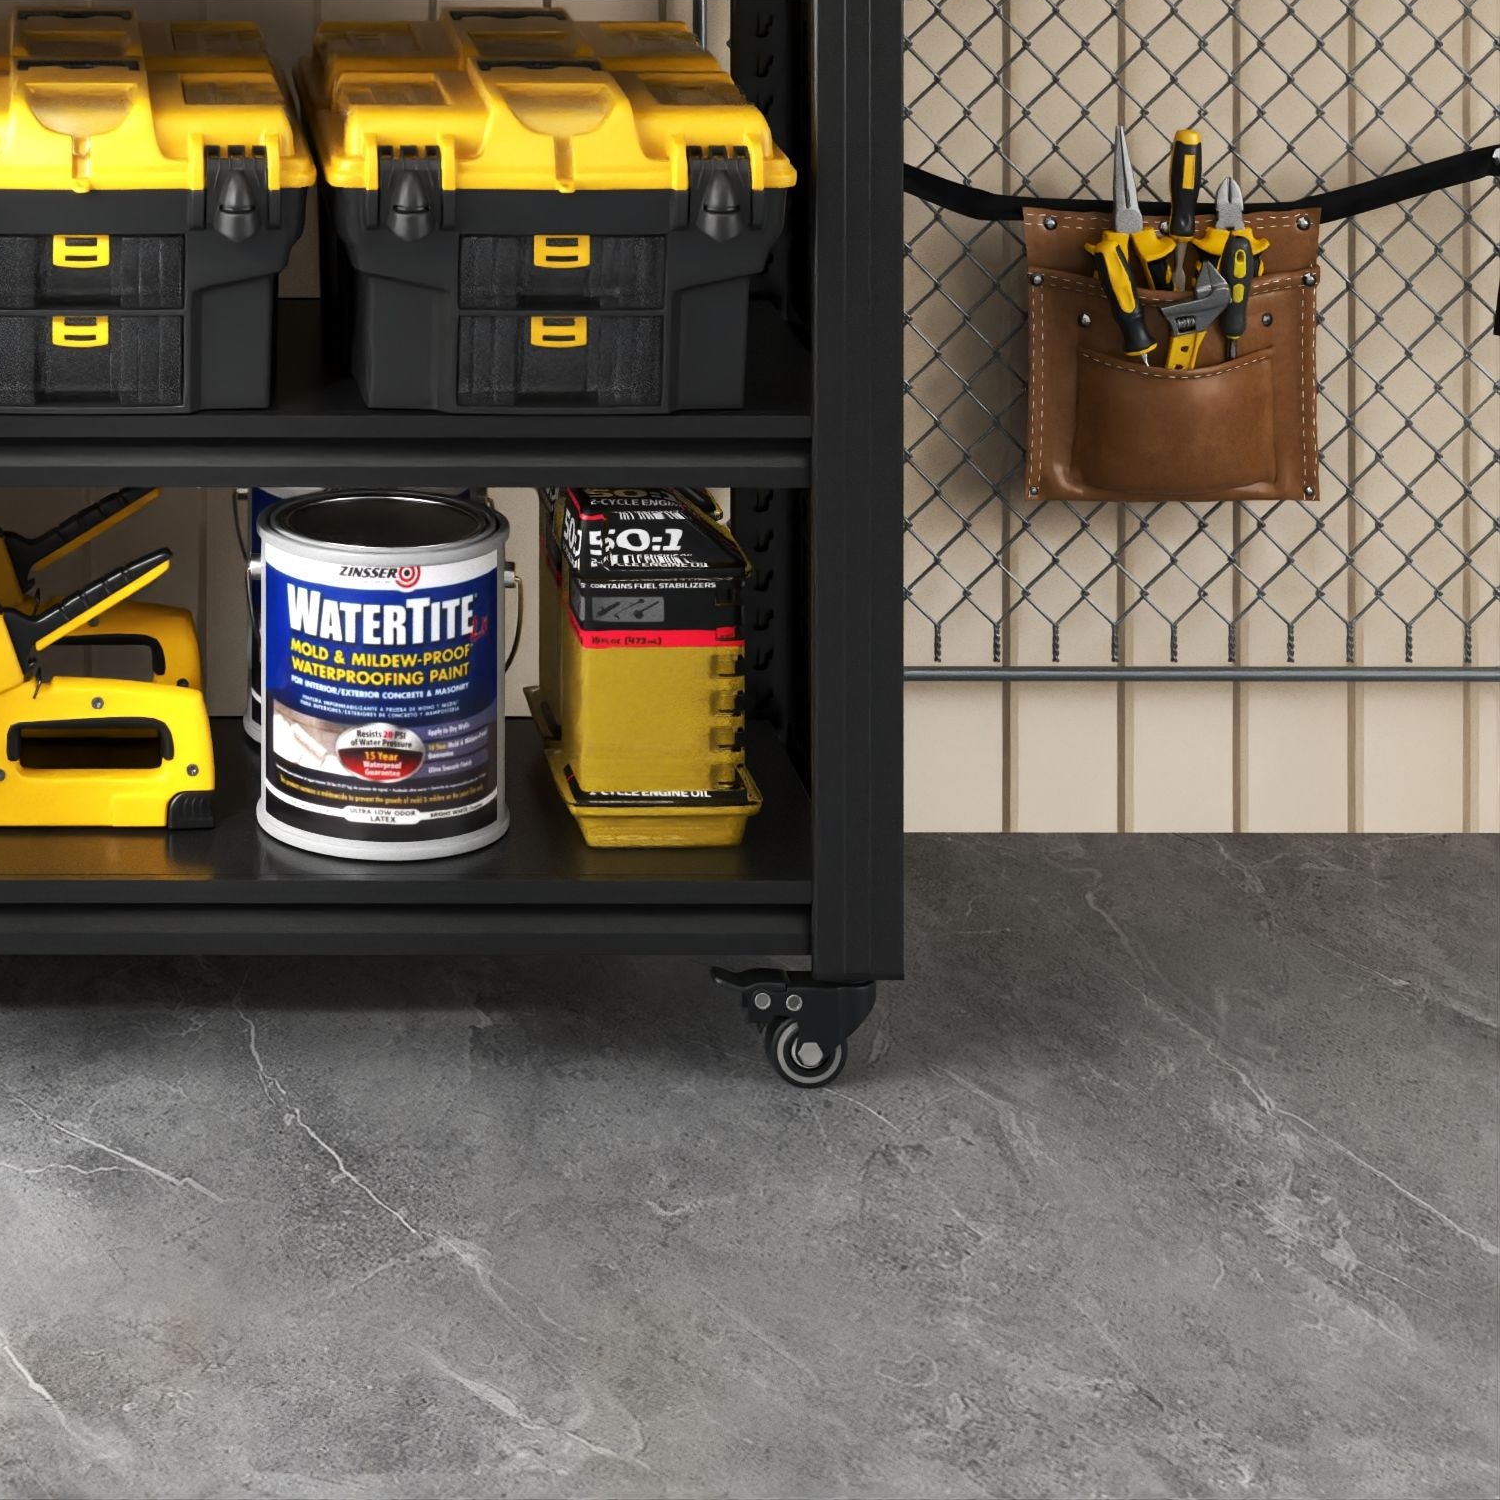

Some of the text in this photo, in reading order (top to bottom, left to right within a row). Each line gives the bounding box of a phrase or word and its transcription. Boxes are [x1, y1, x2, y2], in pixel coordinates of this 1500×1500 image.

[339, 566, 398, 579] ZINSSER
[286, 583, 474, 646] WATERTITE
[291, 638, 471, 668] MOLD & MILDEW-PROOF
[291, 656, 470, 686] WATERPROOFING PAINT
[291, 674, 470, 700] FOR INTERIOR/EXTERIOR CONCRETE & MASONRY
[357, 730, 406, 739] Resists 20 PSI
[363, 761, 402, 770] Waterproof
[364, 751, 398, 761] 15 Year
